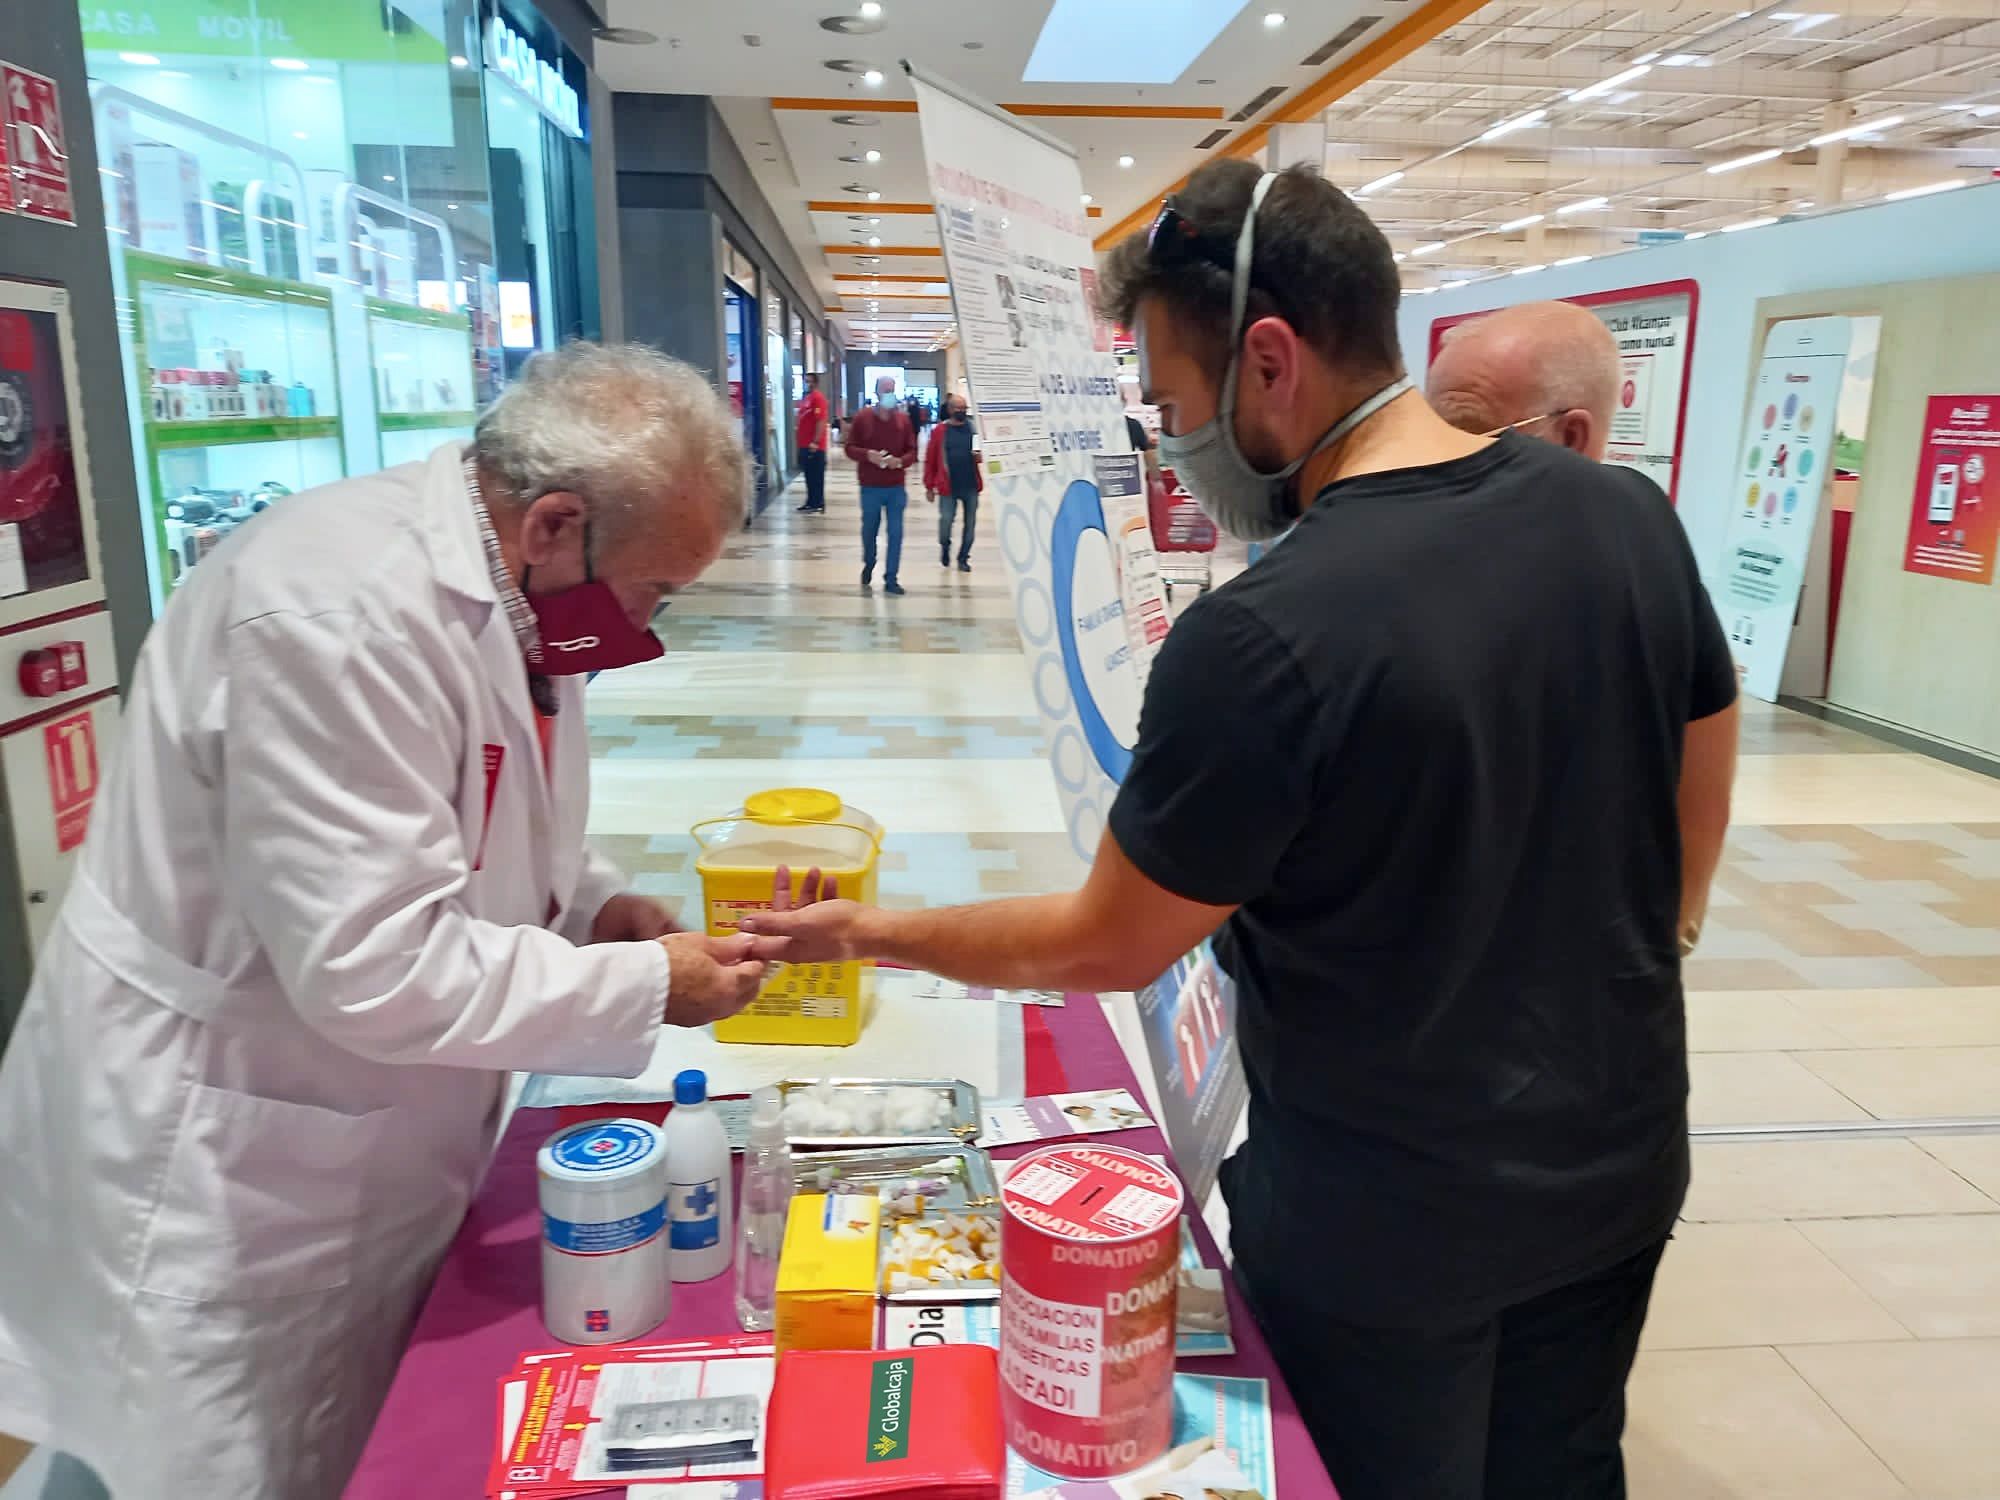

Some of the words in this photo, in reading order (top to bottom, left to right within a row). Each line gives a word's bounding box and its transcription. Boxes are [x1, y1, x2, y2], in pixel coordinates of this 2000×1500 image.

[1052, 1240, 1158, 1269] DONATIVO
[882, 1360, 908, 1433] Globalcaja
[1013, 1419, 1138, 1468] DONATIVO
